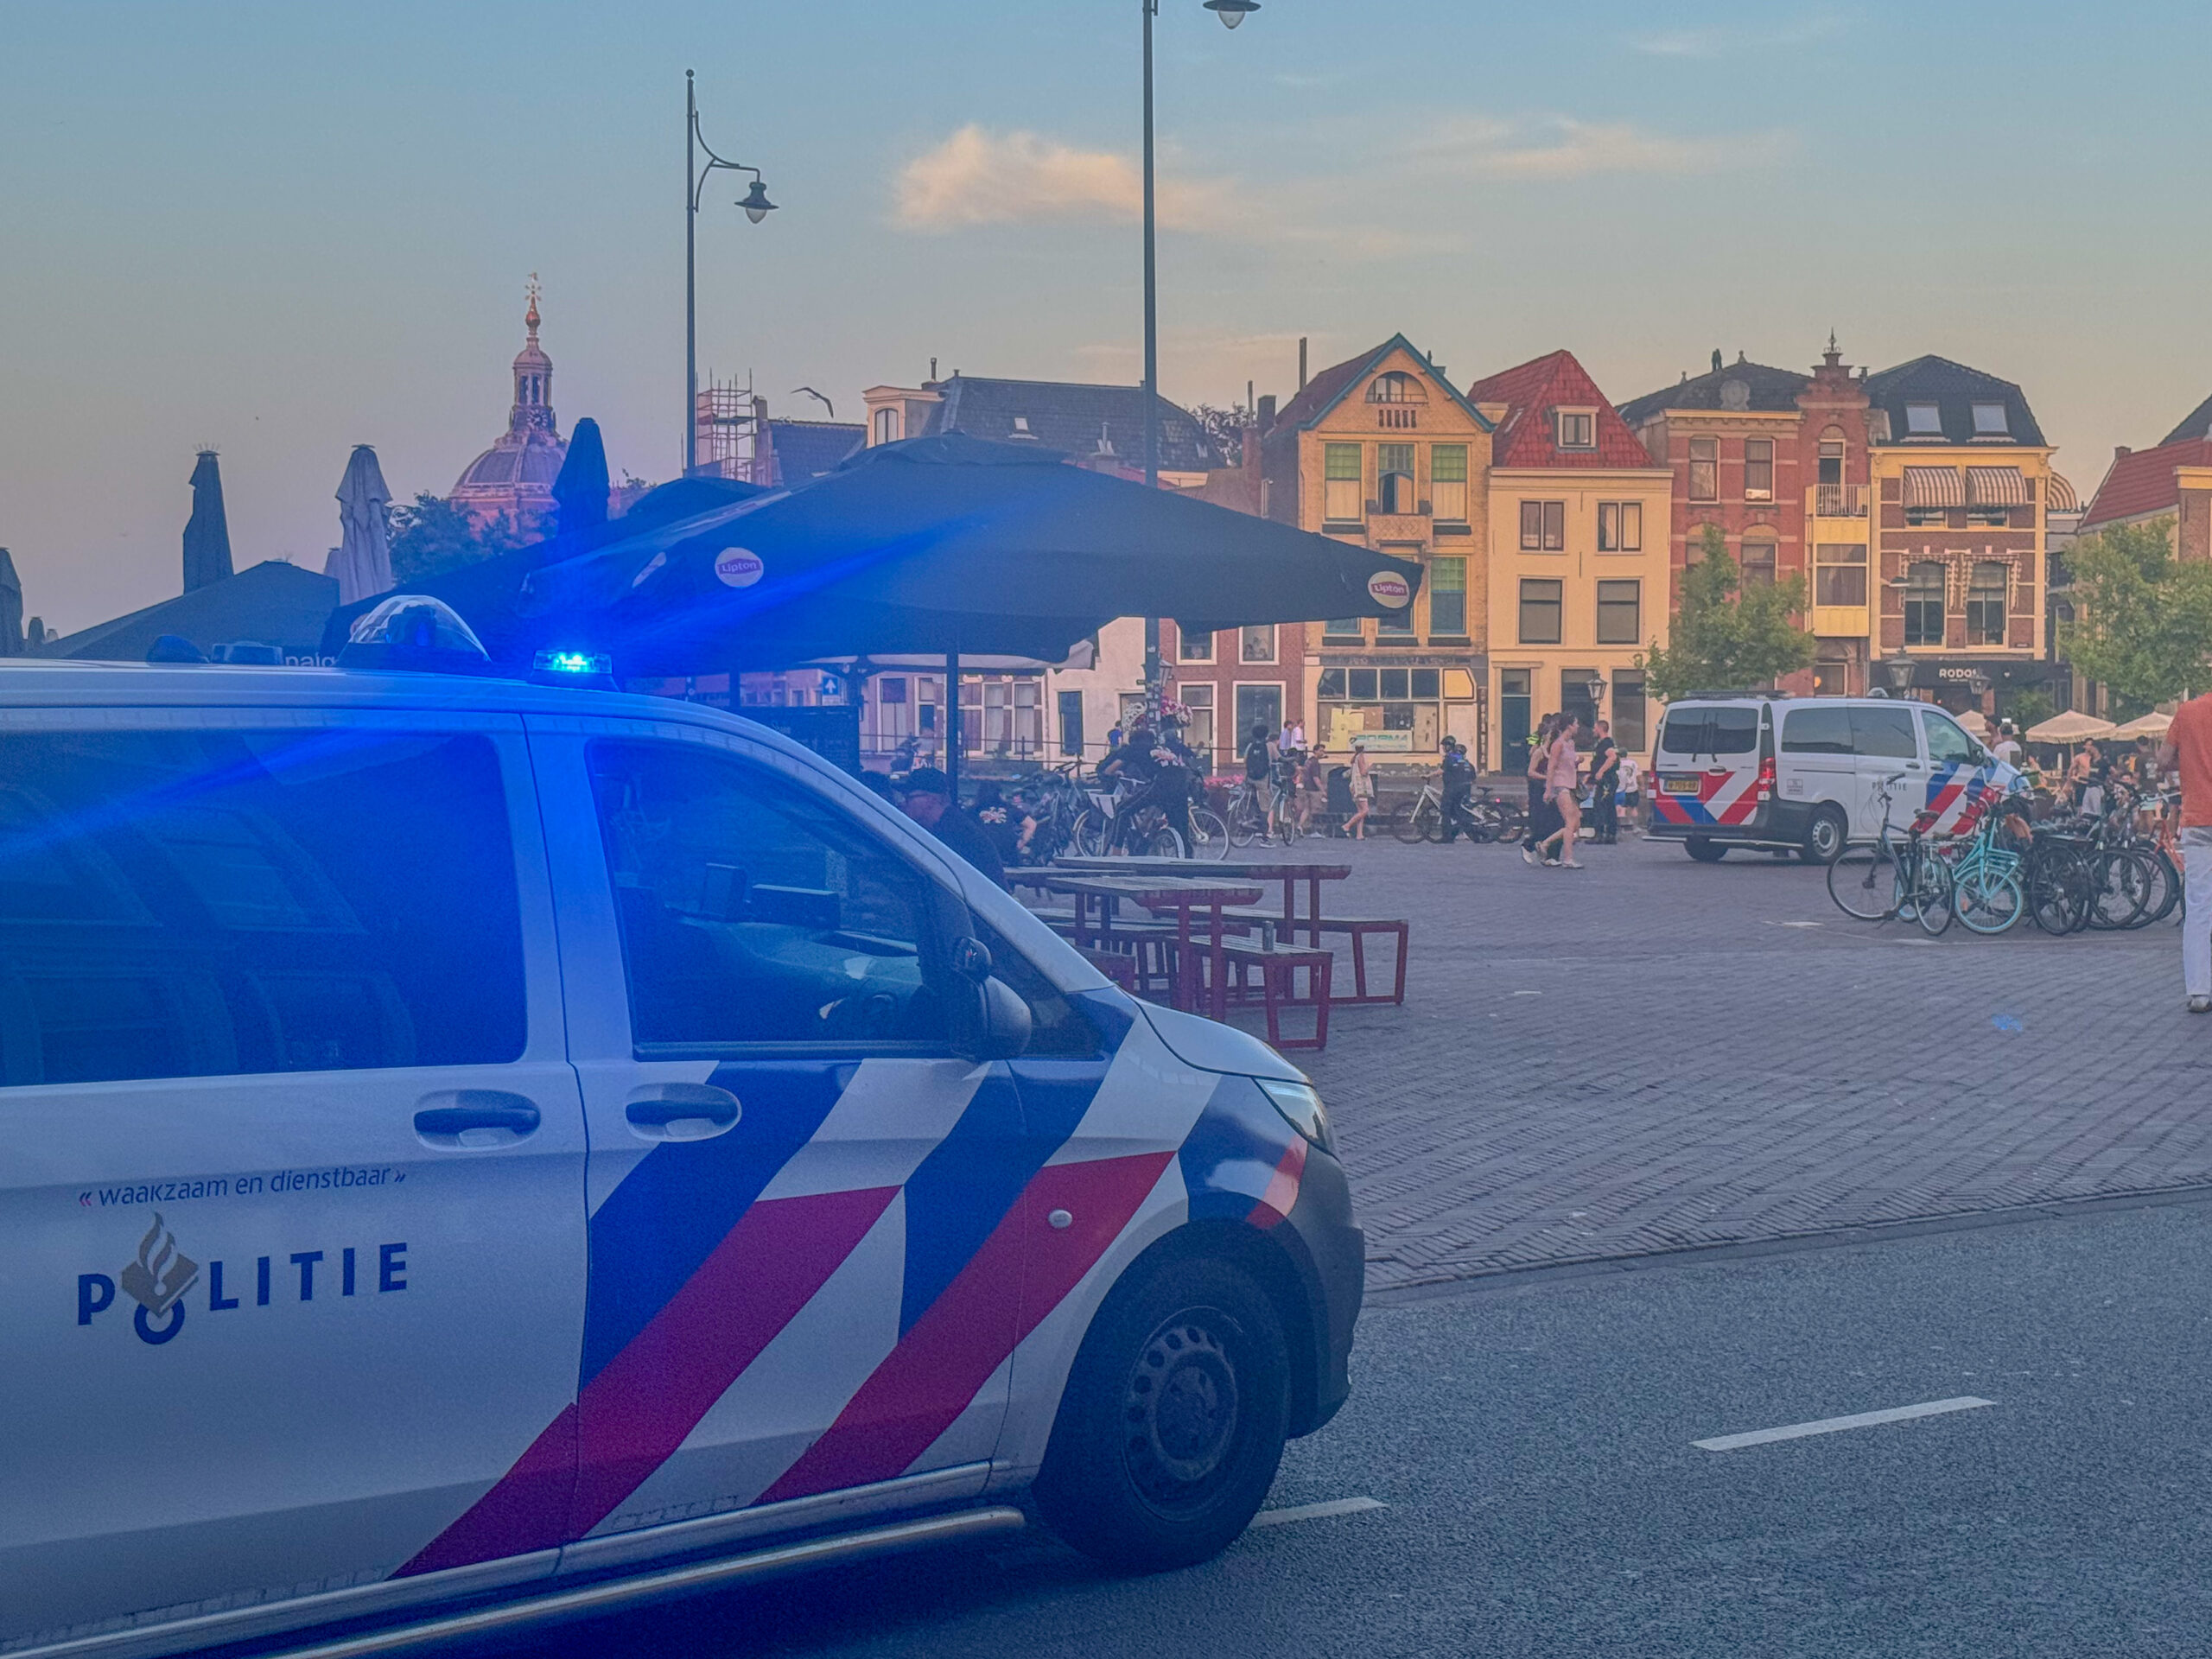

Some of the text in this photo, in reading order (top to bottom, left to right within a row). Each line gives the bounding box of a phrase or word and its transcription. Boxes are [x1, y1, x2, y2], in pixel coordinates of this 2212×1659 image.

[721, 562, 758, 573] Lipton
[1373, 584, 1405, 594] Lipton
[99, 1180, 228, 1206] waakzaam
[235, 1176, 264, 1196] en
[270, 1166, 391, 1192] dienstbaar
[77, 1242, 408, 1345] POLITIE
